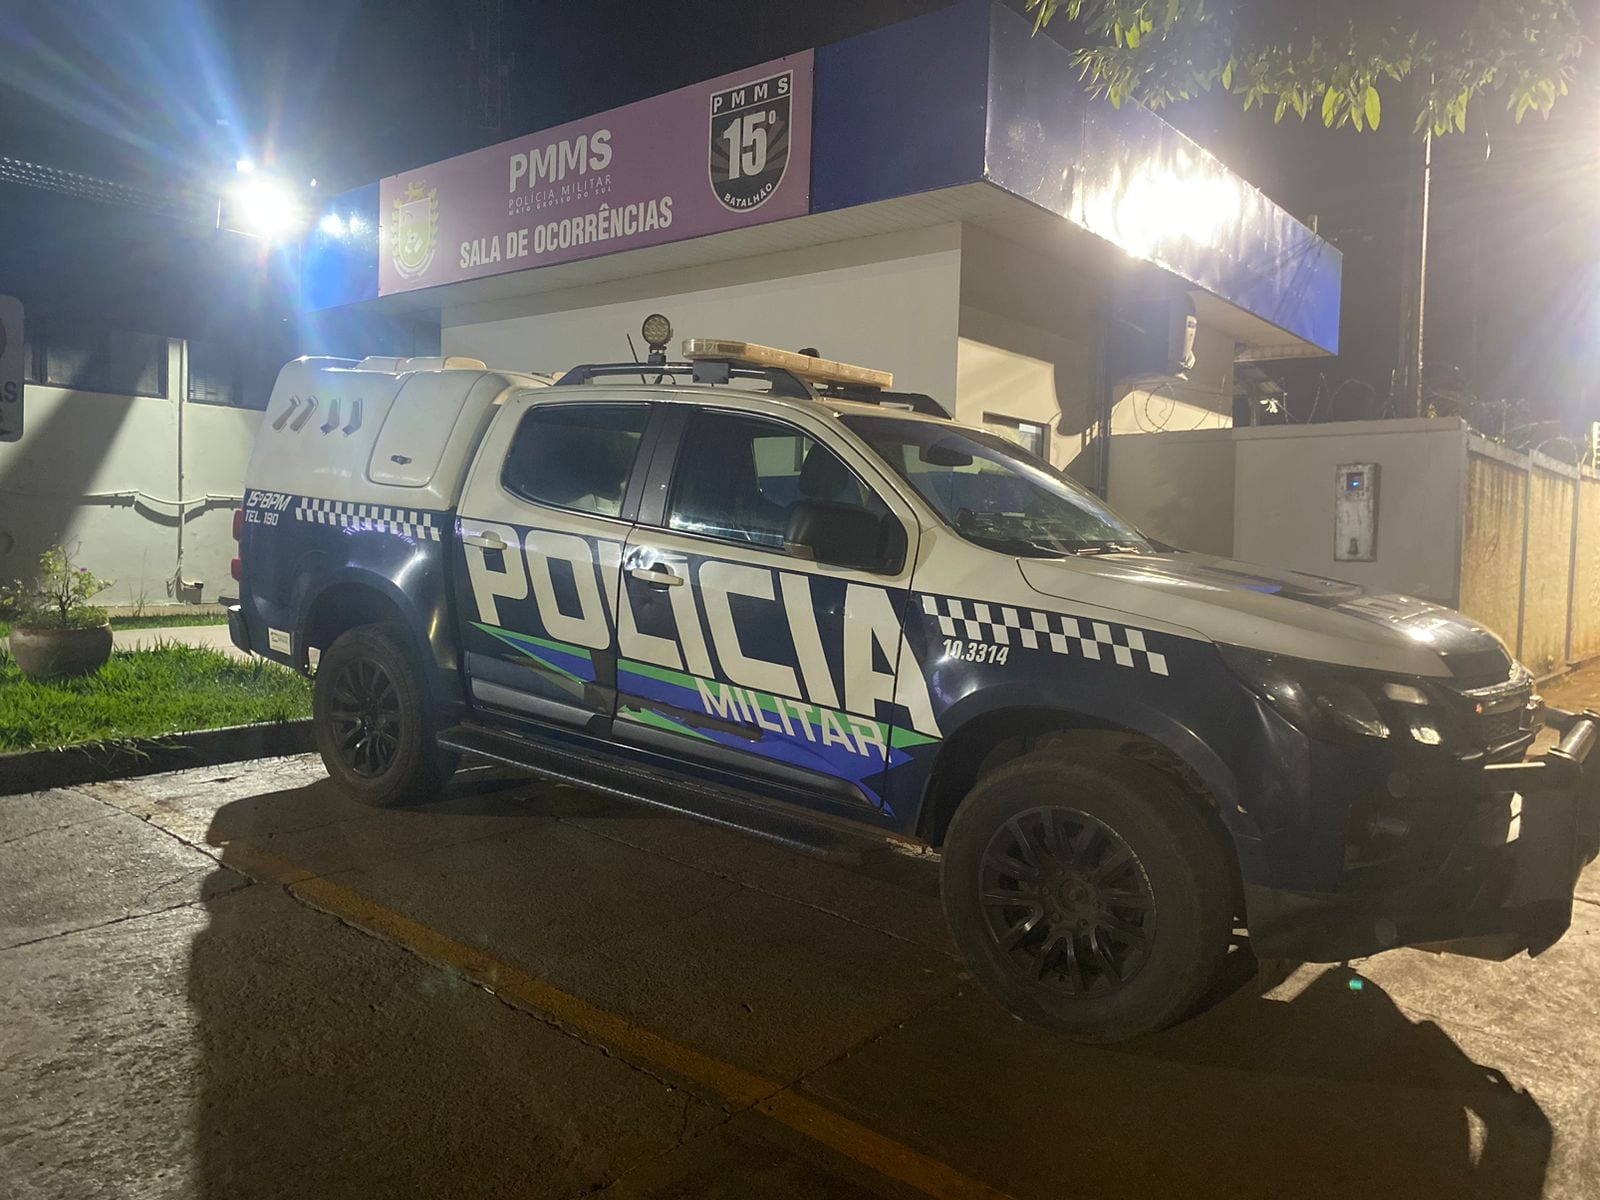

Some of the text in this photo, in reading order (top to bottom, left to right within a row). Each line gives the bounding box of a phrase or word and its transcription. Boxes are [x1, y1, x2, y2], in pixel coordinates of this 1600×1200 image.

[713, 78, 789, 113] PMMS
[509, 129, 612, 193] PMMS
[561, 174, 612, 196] MILITAR
[724, 182, 773, 208] BATALHÃO
[508, 186, 611, 215] MATO GROSSO DO SUL
[459, 196, 673, 269] SALA DE OCORRÊNCIAS
[263, 511, 279, 526] 190
[943, 639, 1010, 666] 10.3314
[695, 677, 891, 762] MILITAR
